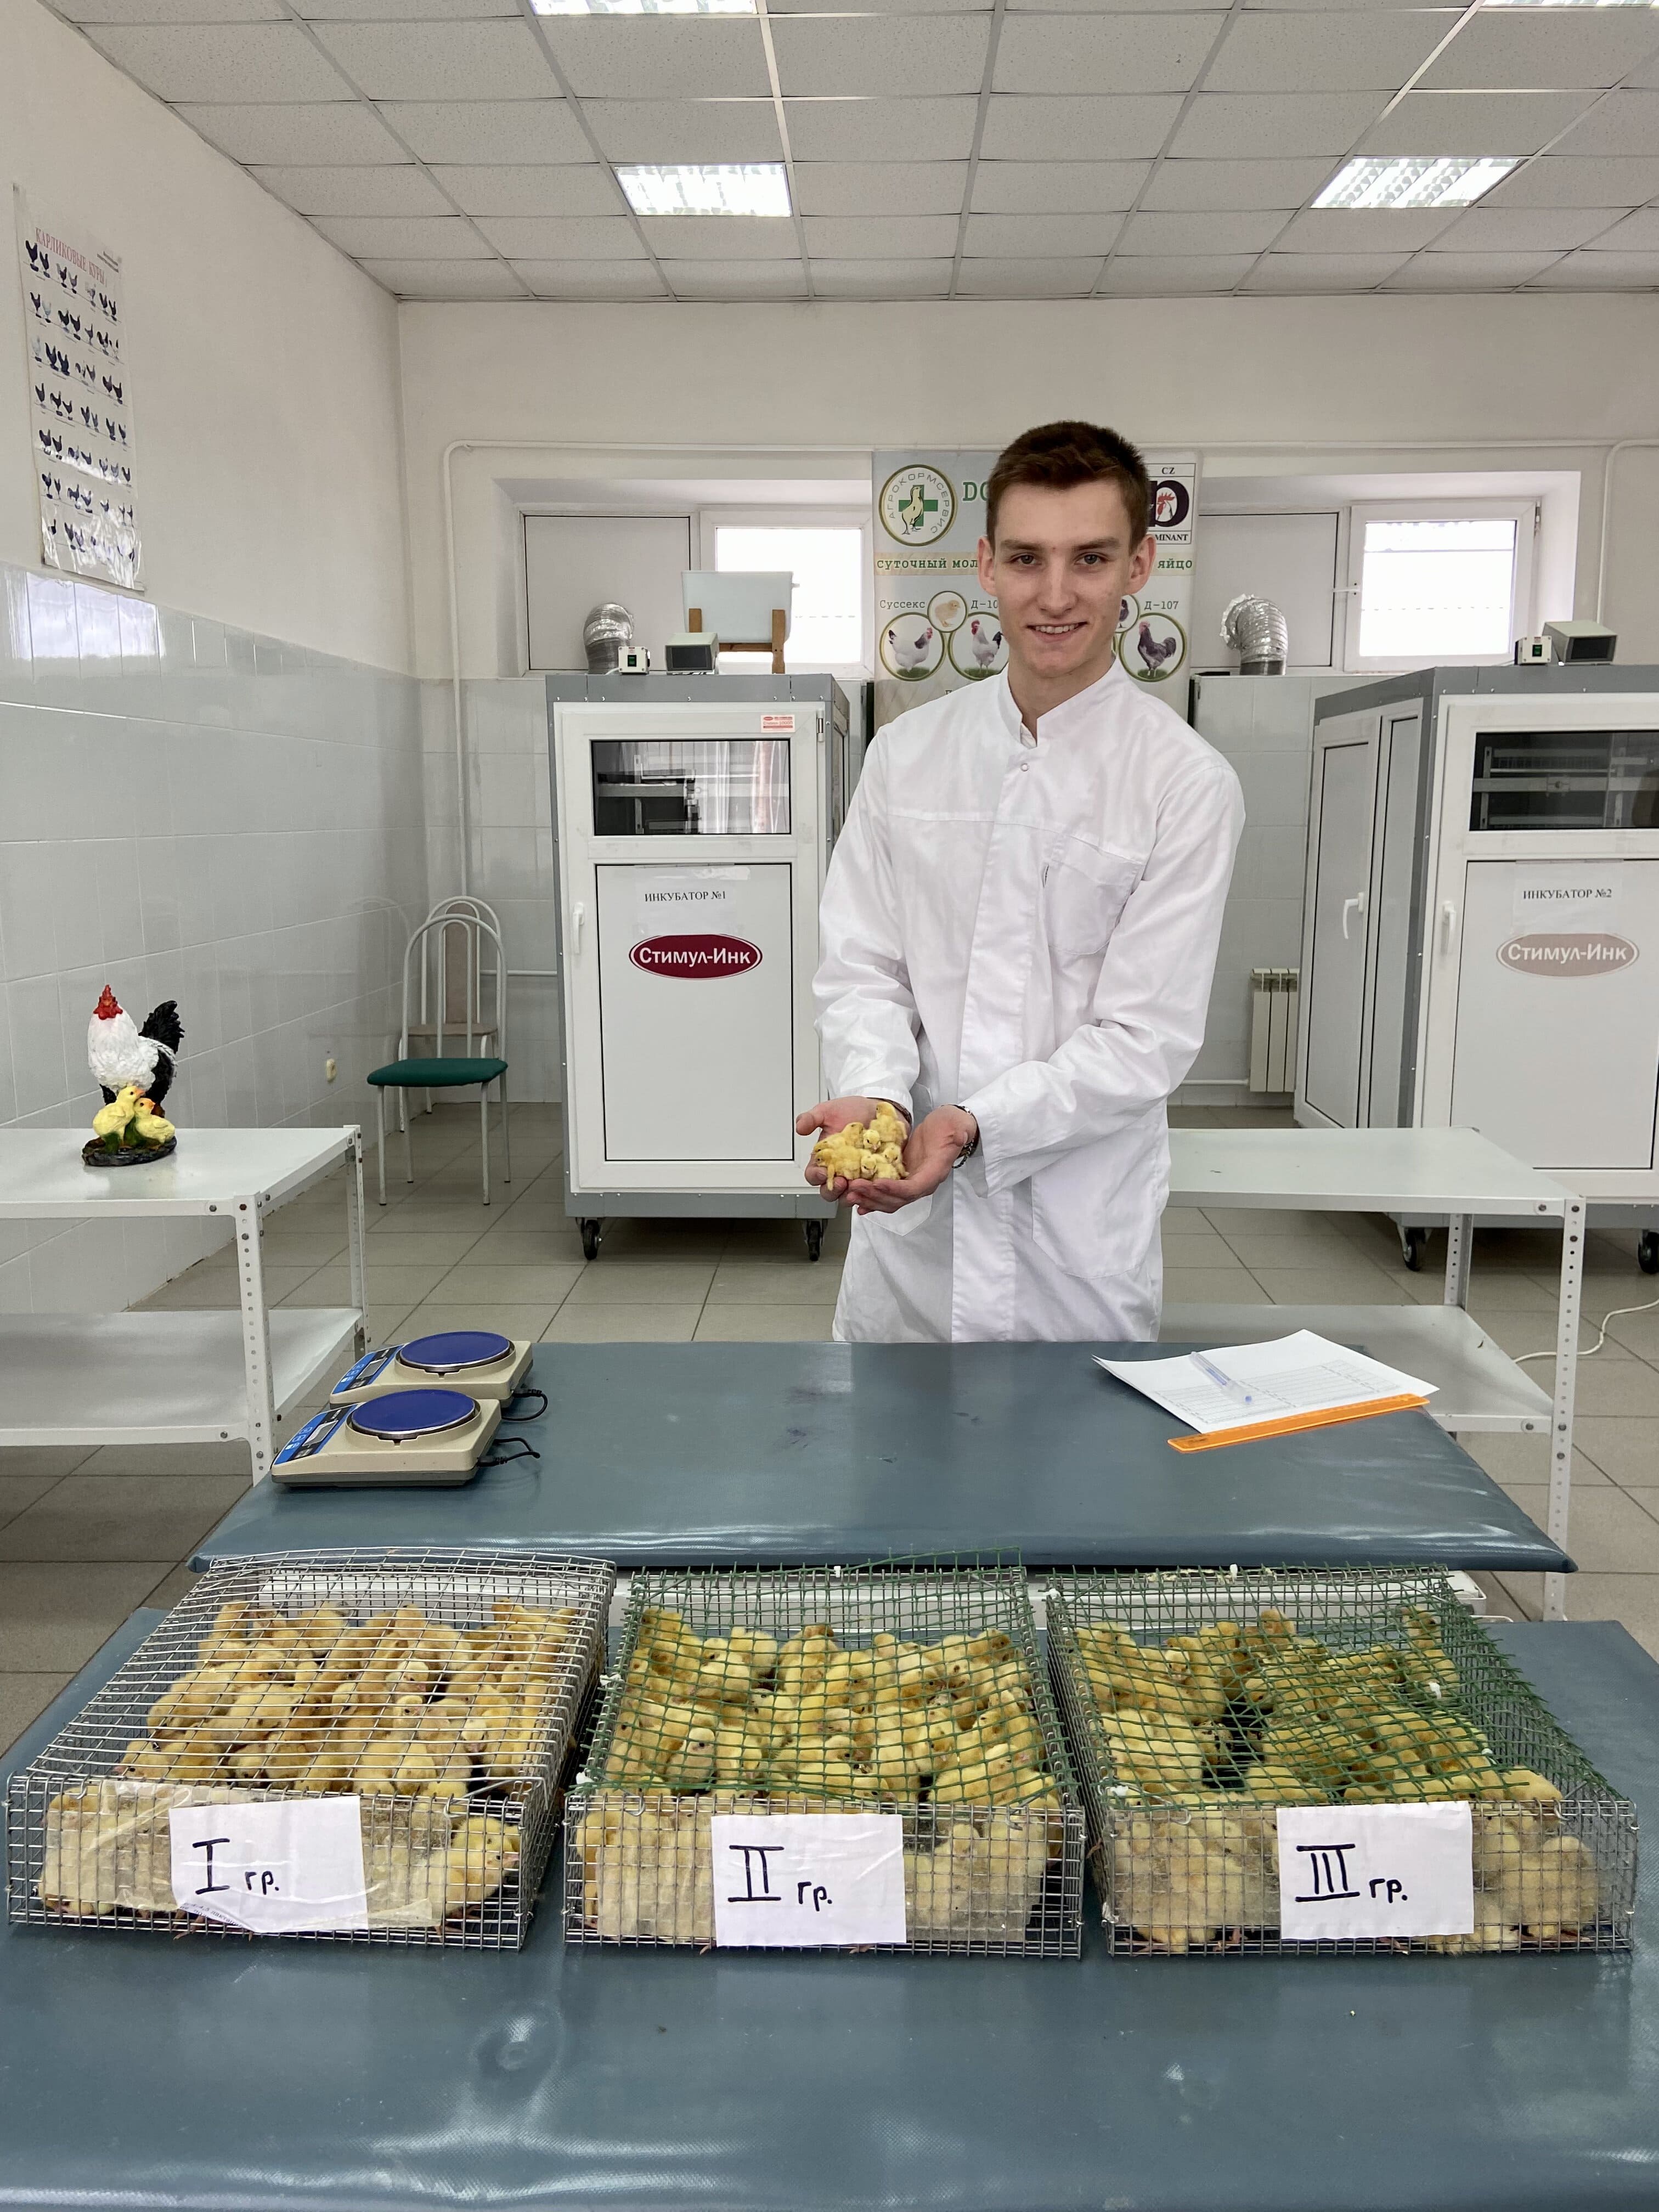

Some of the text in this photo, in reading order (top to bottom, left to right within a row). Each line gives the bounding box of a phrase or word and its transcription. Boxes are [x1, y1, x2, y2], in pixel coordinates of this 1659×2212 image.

[36, 227, 87, 272] КАРЛИКОВЫЕ
[89, 261, 105, 285] КУРЫ
[887, 473, 950, 534] АГРОКОРМСЕРВИС
[879, 600, 926, 610] Суссекс
[1144, 601, 1179, 611] Д-107
[645, 890, 726, 902] ИНКУБАТОР №1
[1523, 888, 1612, 900] ИНКУБАТОР №2
[639, 947, 751, 967] Стимул-Инк
[1508, 943, 1627, 964] Стимул-Инк
[245, 1871, 279, 1895] гр.
[728, 1845, 833, 1912] II гр.
[1295, 1843, 1408, 1904] III гр.
